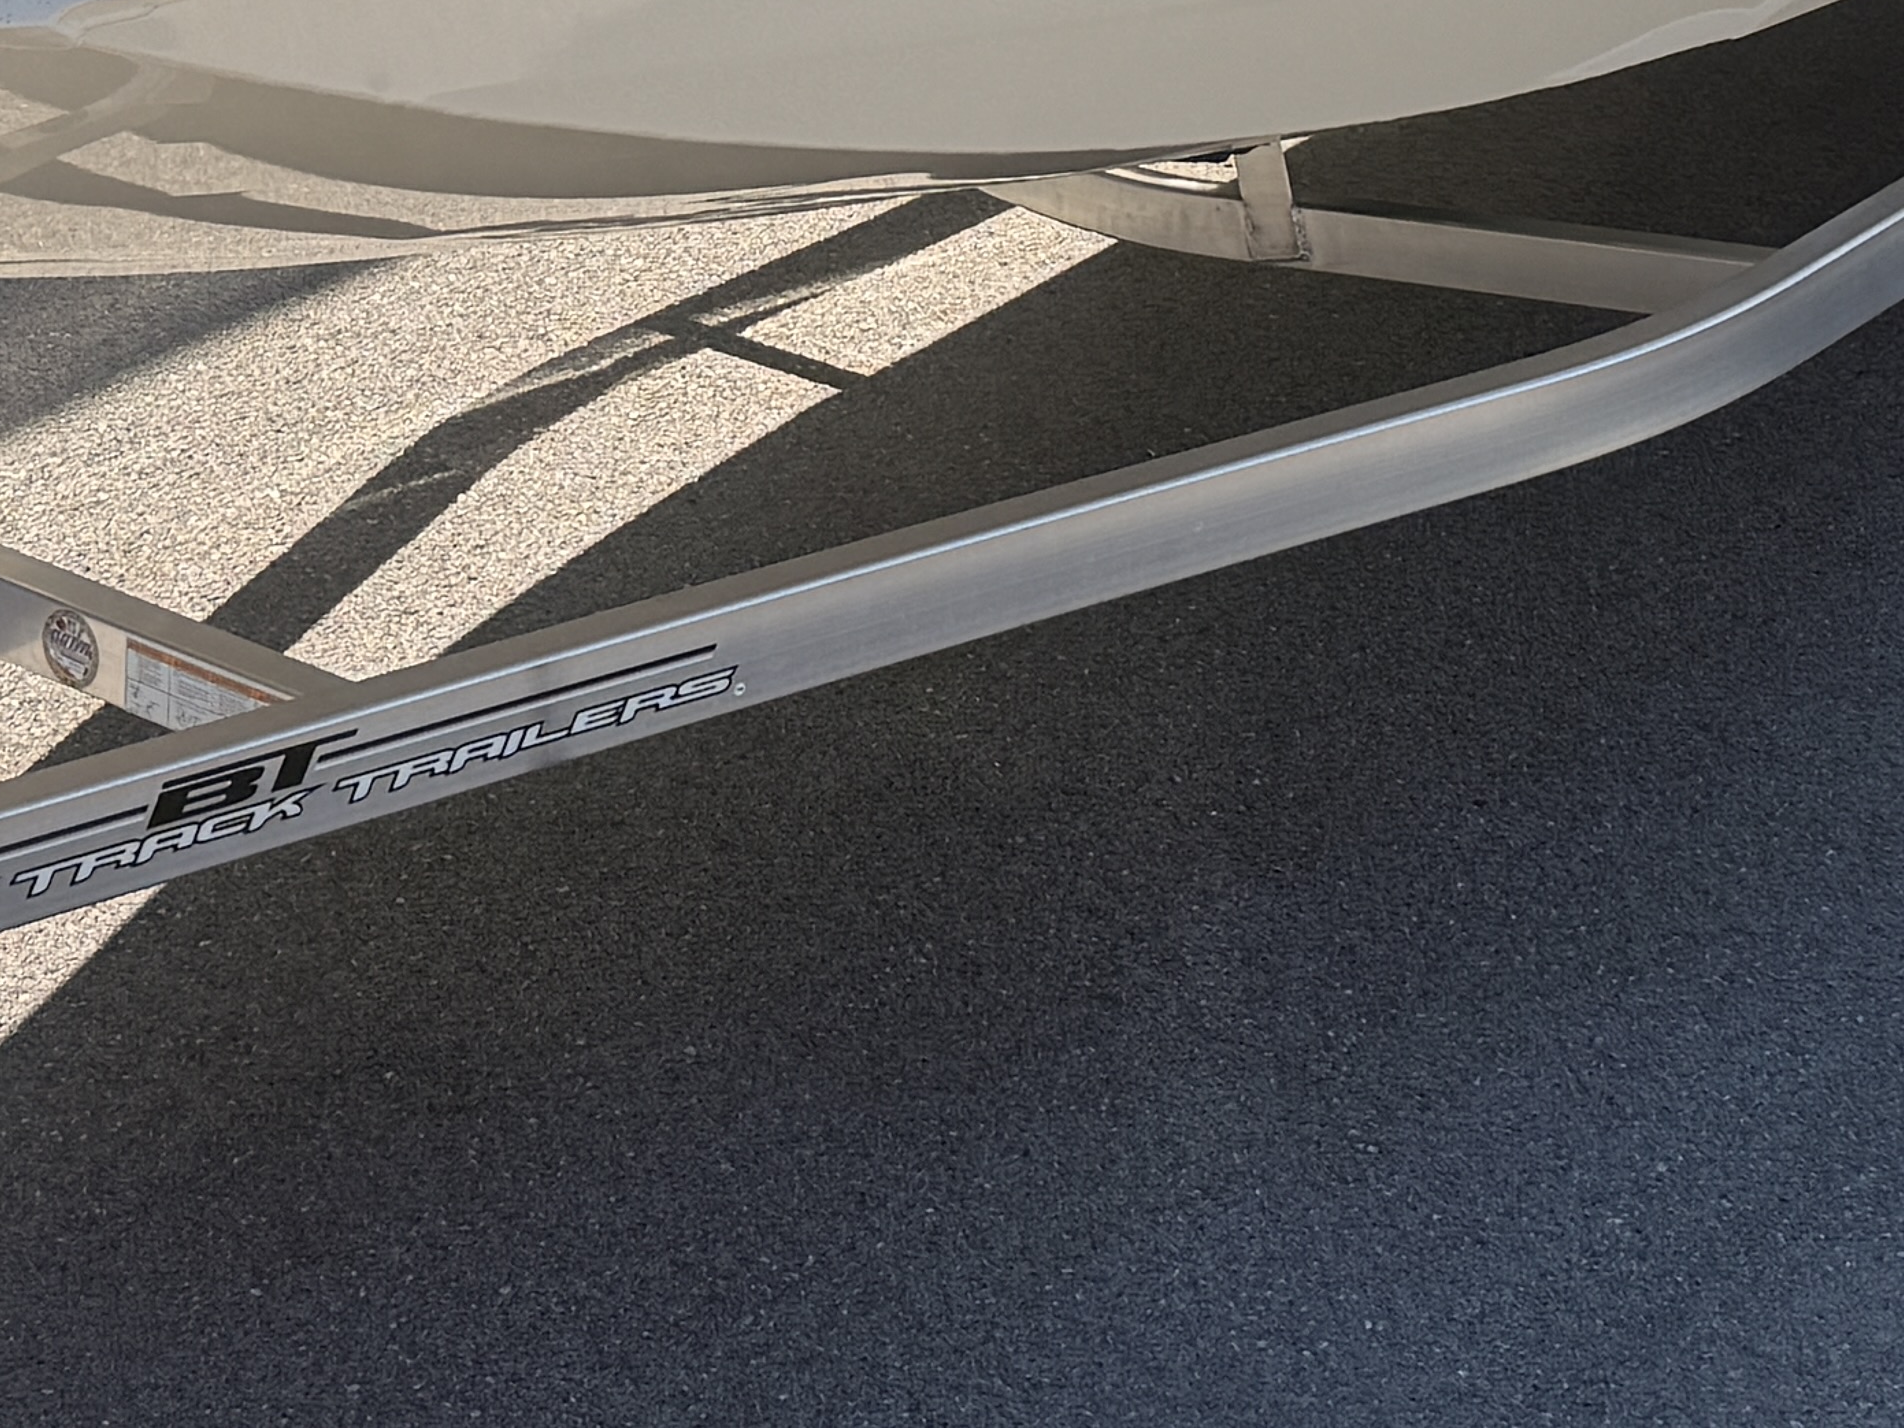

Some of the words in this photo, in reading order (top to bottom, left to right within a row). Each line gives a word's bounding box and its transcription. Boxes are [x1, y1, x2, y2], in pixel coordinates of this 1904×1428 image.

[10, 783, 326, 900] TRACK
[331, 665, 740, 805] TRAILERS
[147, 729, 358, 831] BT
